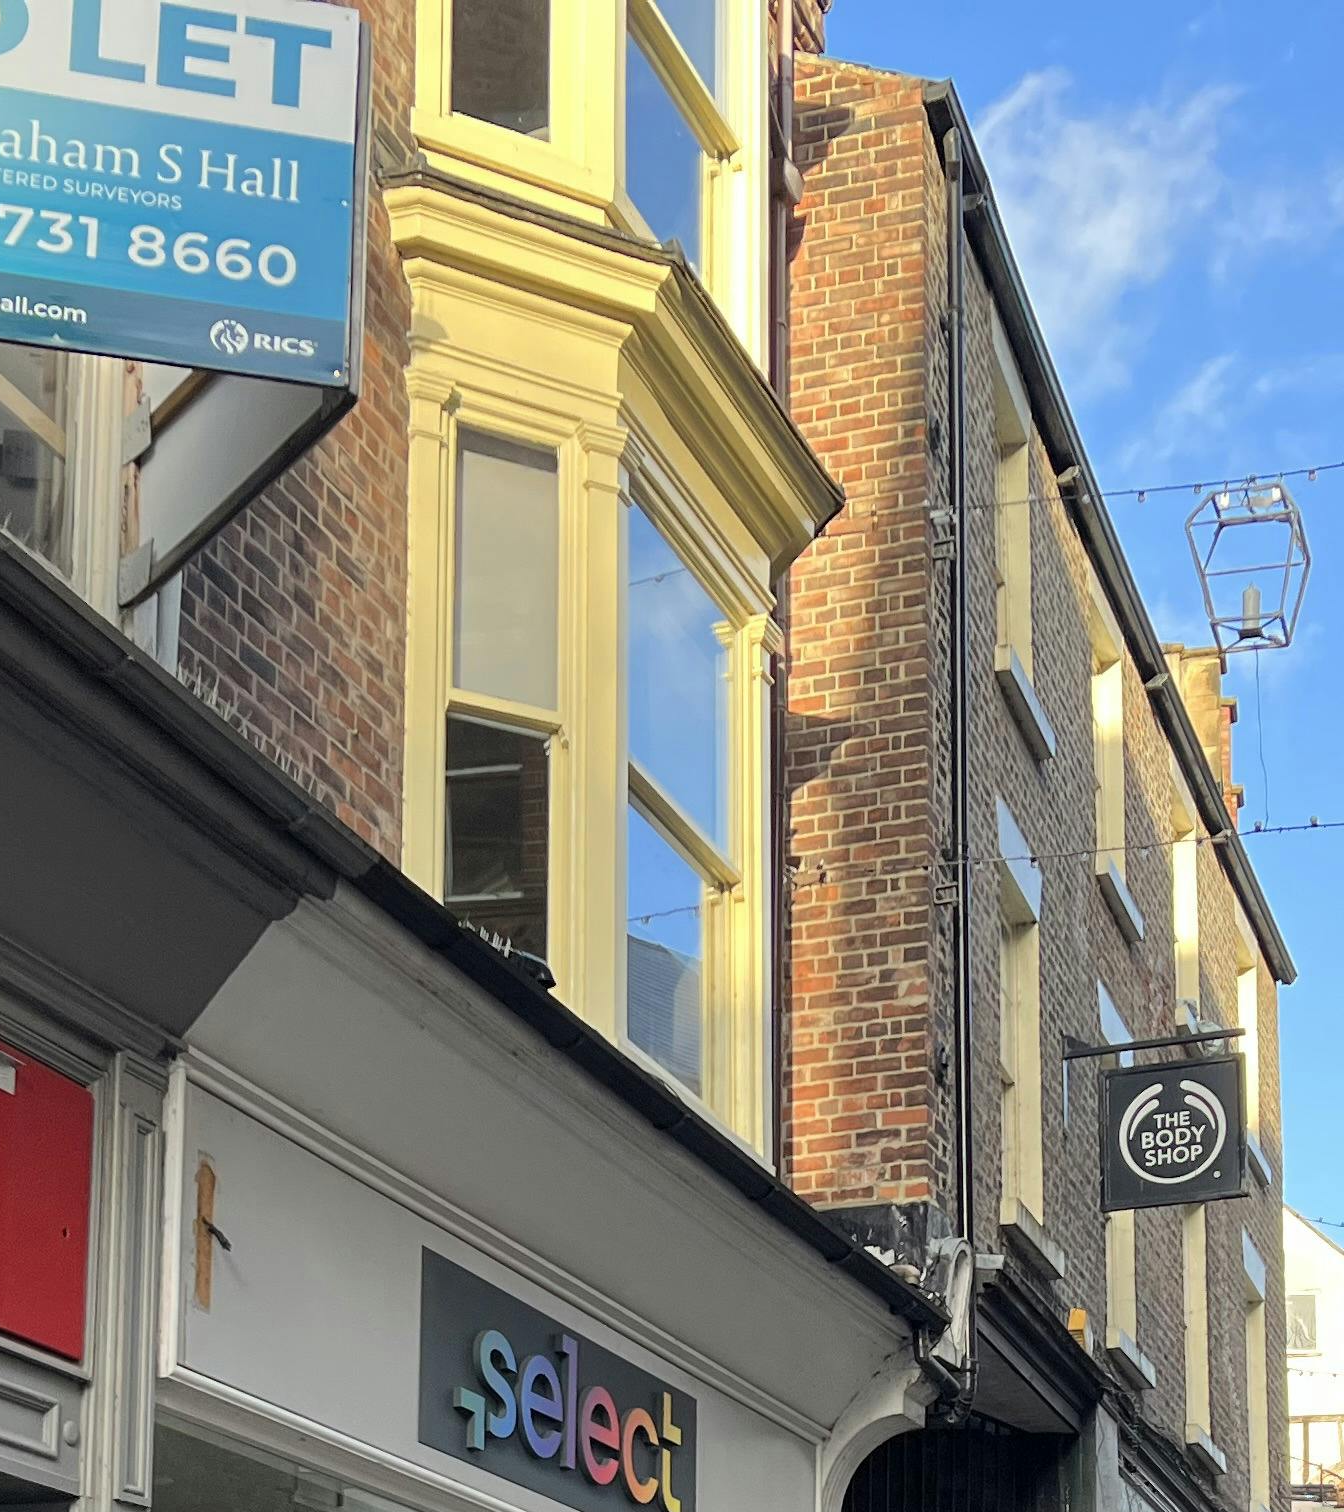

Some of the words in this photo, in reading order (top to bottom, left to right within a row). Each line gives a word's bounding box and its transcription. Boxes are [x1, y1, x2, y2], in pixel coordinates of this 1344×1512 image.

[69, 0, 334, 109] LET
[156, 143, 184, 184] S
[197, 149, 300, 203] Hall
[62, 178, 183, 211] SURVEYORS
[127, 224, 297, 287] 8660
[253, 332, 315, 357] RICS
[1153, 1110, 1191, 1129] THE
[1141, 1124, 1207, 1150] BODY
[1144, 1144, 1203, 1167] SHOP
